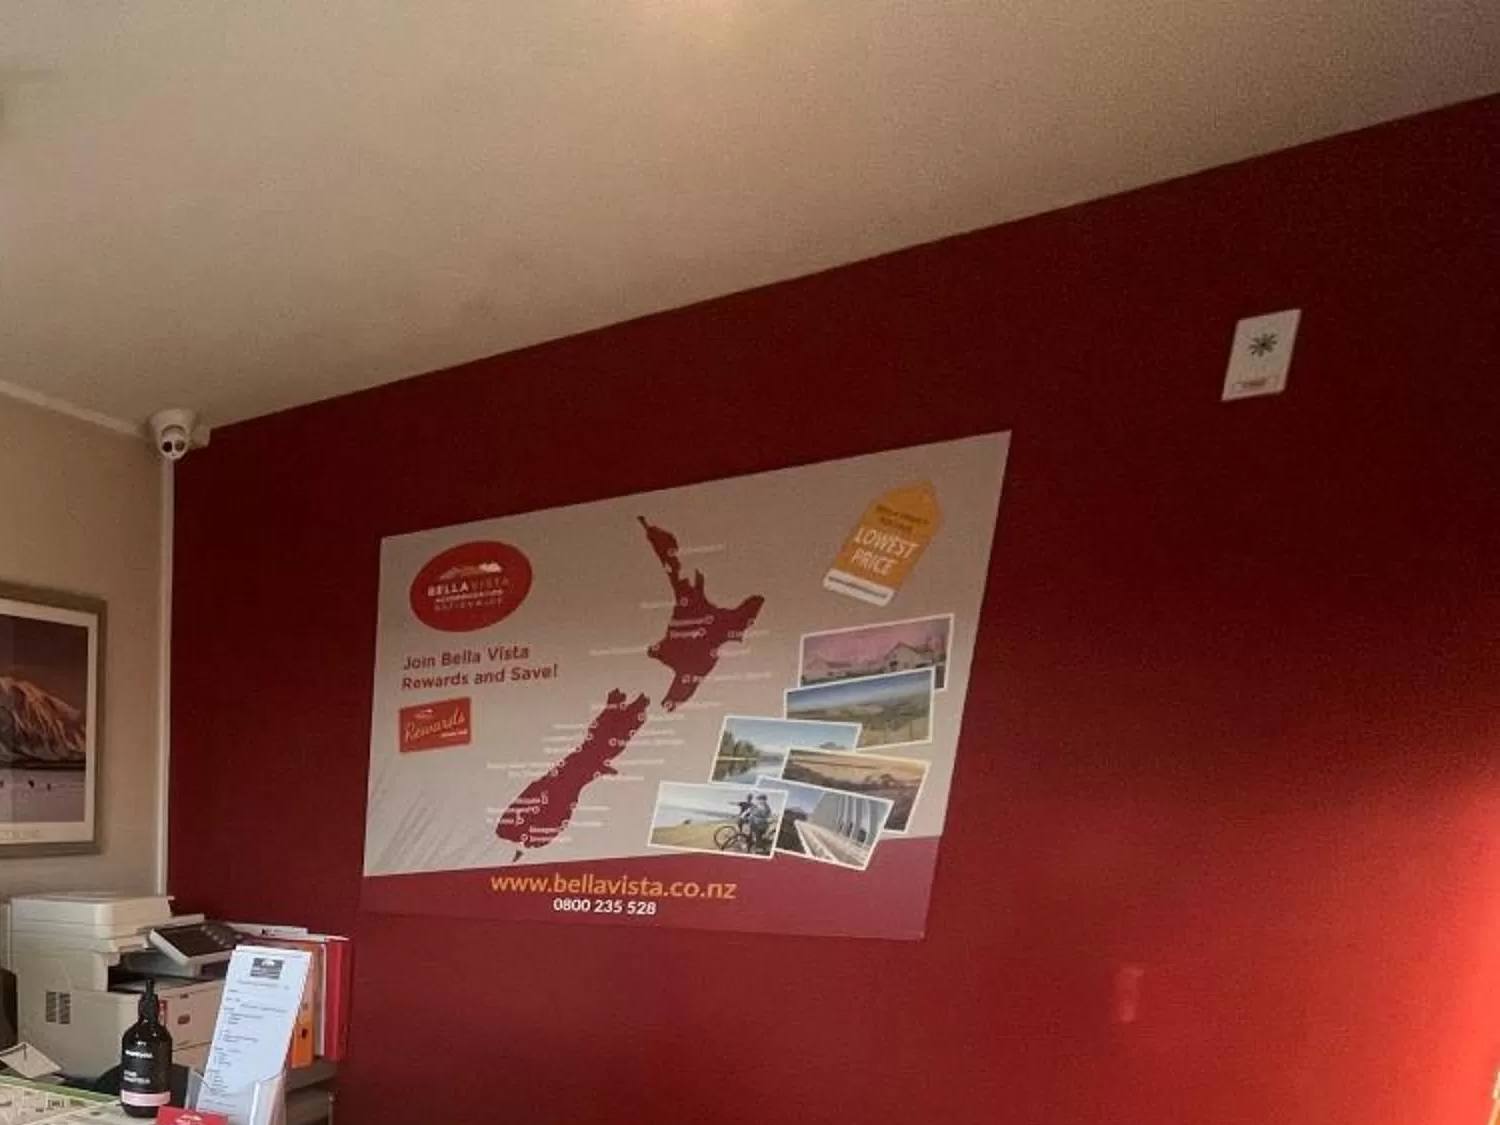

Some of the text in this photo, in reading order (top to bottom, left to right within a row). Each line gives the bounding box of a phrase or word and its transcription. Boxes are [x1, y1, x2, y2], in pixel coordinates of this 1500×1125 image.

[853, 527, 920, 559] LOWEST
[851, 547, 899, 576] PRICE
[427, 580, 469, 597] BELLA
[403, 645, 529, 670] Join Bella Vista
[402, 663, 559, 689] Rewards and Save!
[404, 707, 466, 743] Rewards
[490, 872, 738, 900] www.bellavista.co.nz
[553, 897, 657, 916] 0800 235 528
